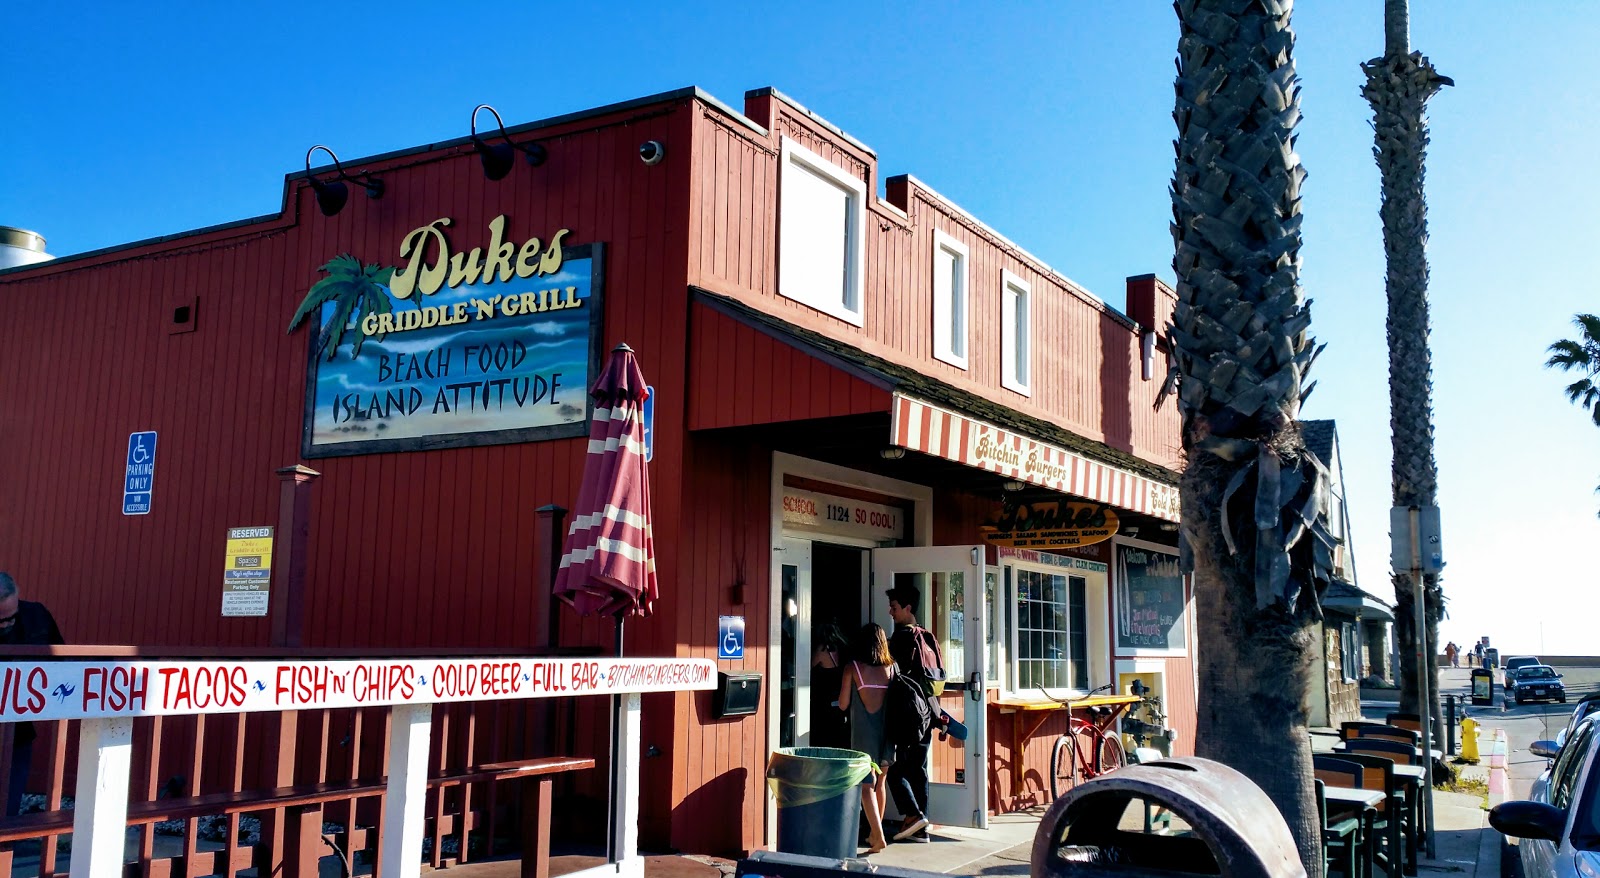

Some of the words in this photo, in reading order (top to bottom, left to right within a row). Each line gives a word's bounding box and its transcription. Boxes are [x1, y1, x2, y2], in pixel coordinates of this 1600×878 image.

[390, 214, 569, 299] Dukes
[361, 301, 469, 336] GRIDDLE
[501, 286, 582, 316] GRILL
[378, 347, 451, 383] BEACH
[464, 339, 527, 376] FOOD
[332, 386, 423, 424] ISLAND
[432, 373, 563, 416] ATTITUDE
[128, 463, 152, 475] PARKING
[975, 434, 1024, 466] Bitchin'
[1025, 450, 1067, 481] Burgers
[130, 477, 148, 490] ONLY
[126, 503, 147, 511] ACCESSIBLE
[783, 496, 818, 516] SCHOOL
[826, 503, 850, 522] 1124
[855, 508, 867, 525] SO
[870, 511, 896, 530] COOL!
[997, 498, 1107, 532] Dukes
[231, 528, 269, 538] RESERVED
[82, 666, 149, 713] FISH
[158, 666, 247, 710] TACOS
[276, 665, 328, 705] FISH
[353, 664, 414, 702] CHIPS
[432, 664, 477, 698] COLD
[480, 662, 521, 695] BEER
[532, 662, 567, 692] FULL
[572, 662, 599, 691] BAR
[608, 663, 710, 688] BITCHINBURGERS.COM
